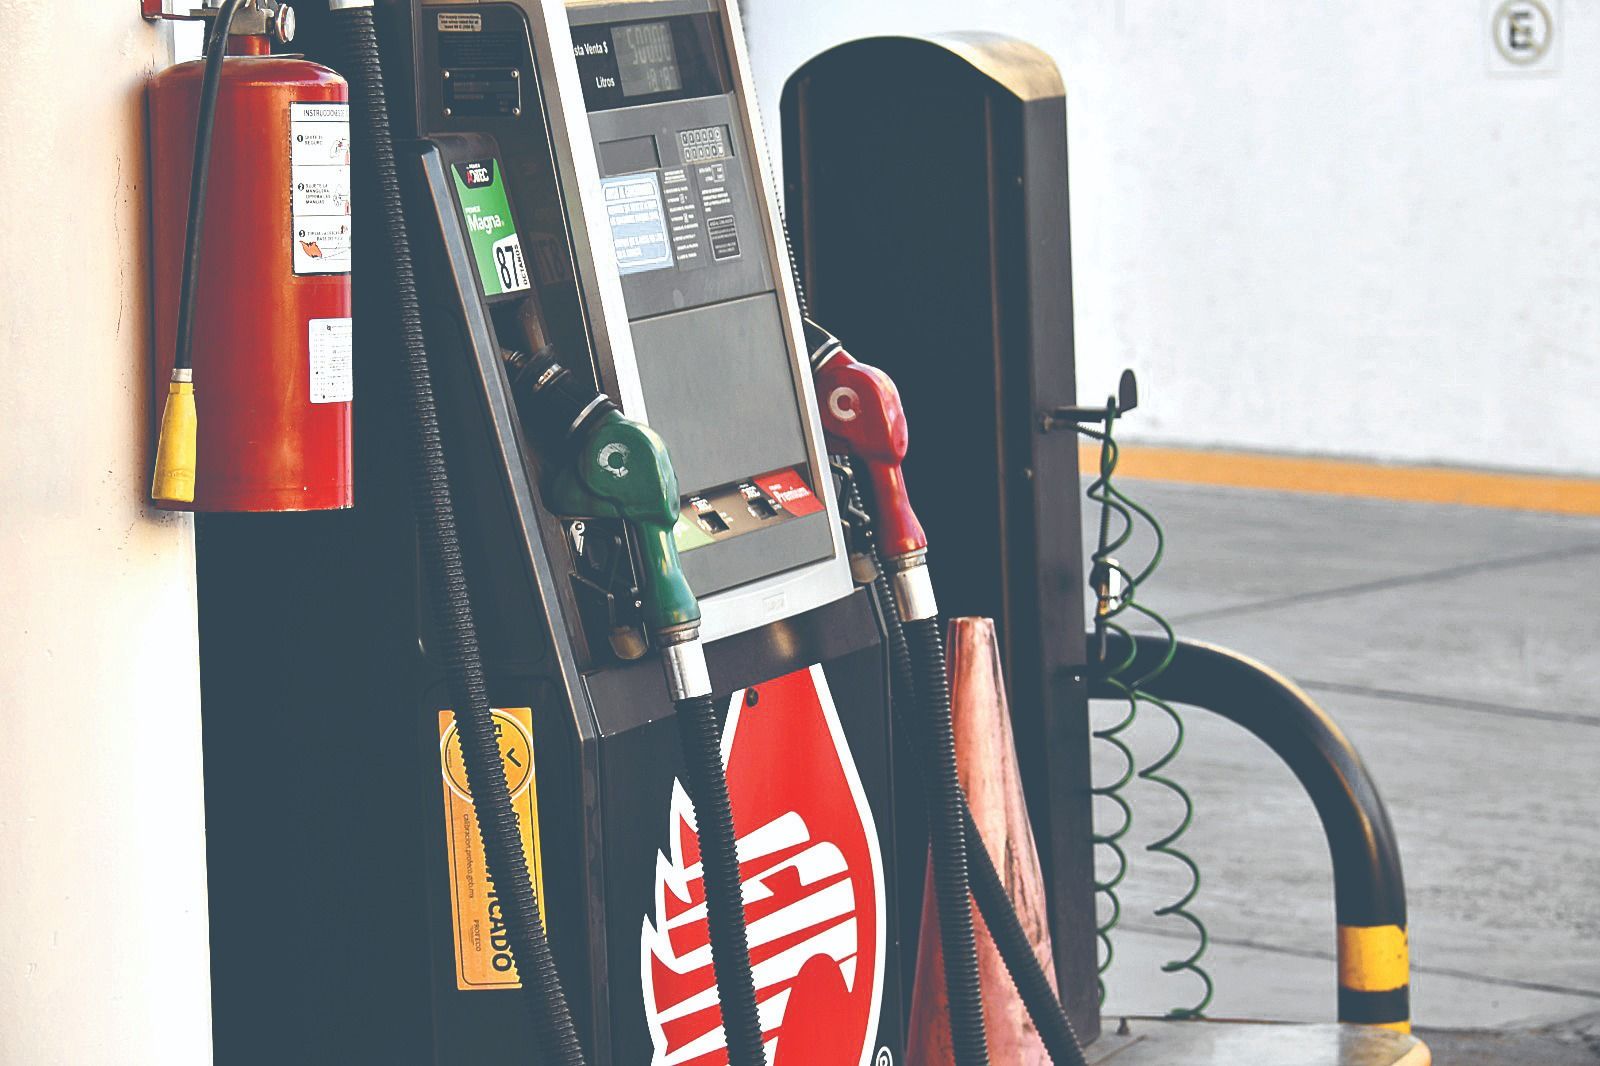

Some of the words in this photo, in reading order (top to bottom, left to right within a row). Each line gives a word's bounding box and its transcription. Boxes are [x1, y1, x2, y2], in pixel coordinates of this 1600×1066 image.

[573, 45, 585, 56] sta
[584, 42, 603, 55] Venta
[602, 41, 609, 54] $
[595, 76, 616, 89] Litros
[467, 214, 502, 234] Magna
[496, 245, 520, 289] 87
[514, 244, 528, 285] OCTANOS
[473, 919, 482, 952] PROFECO
